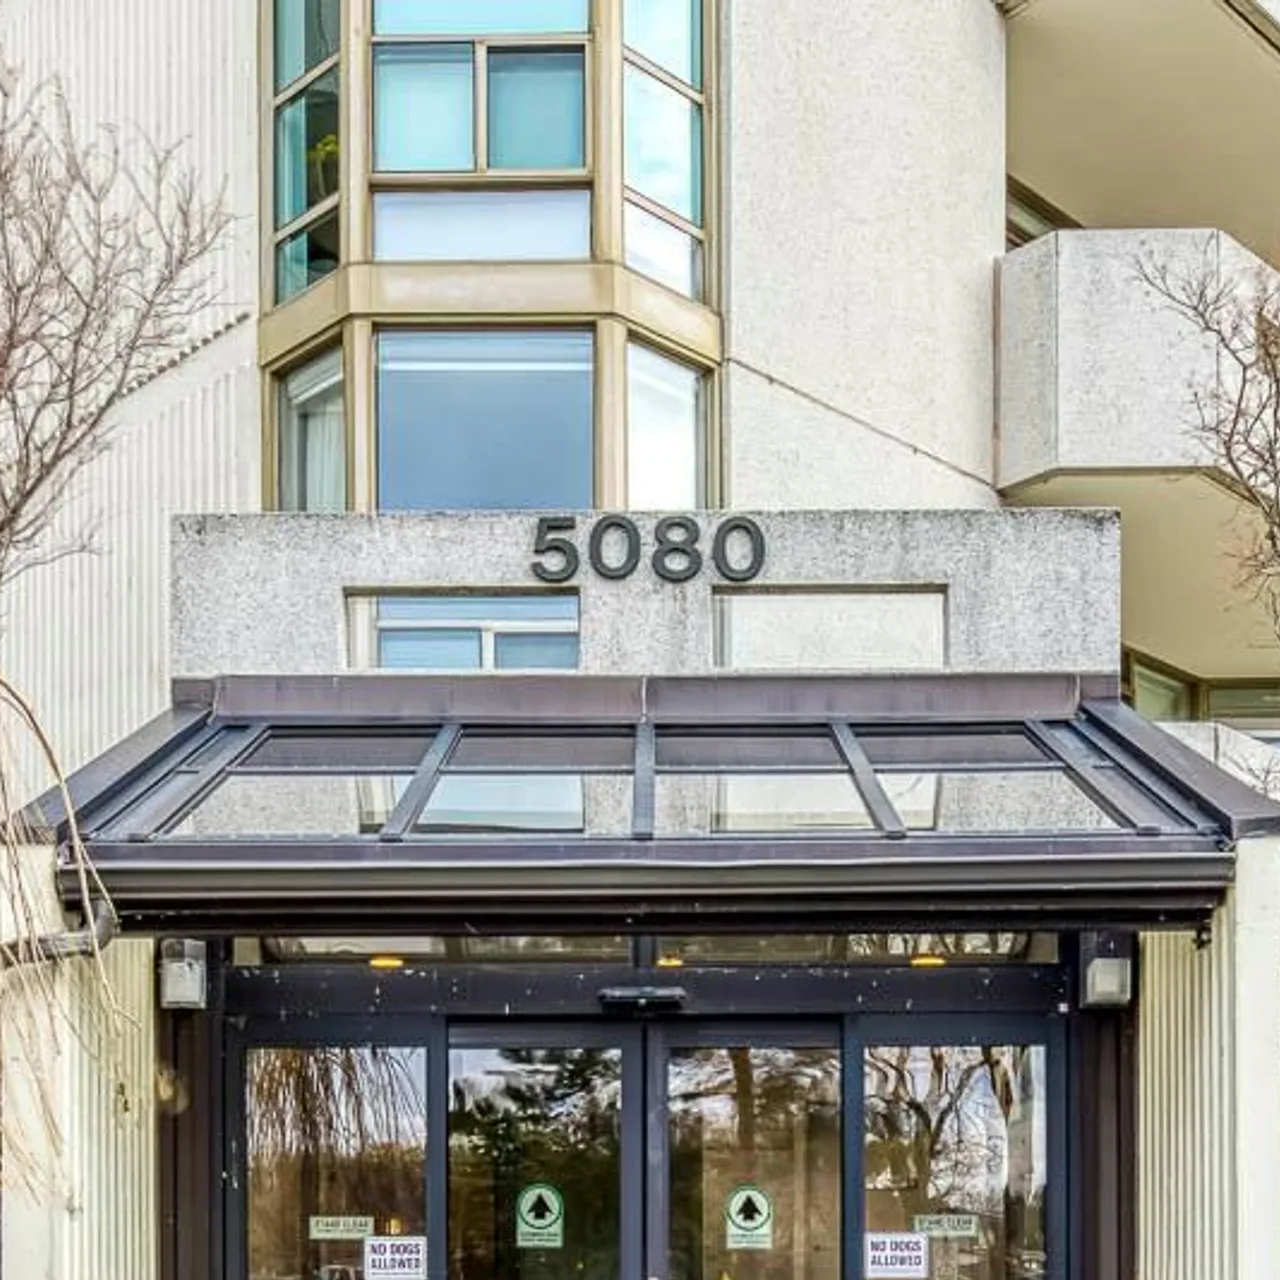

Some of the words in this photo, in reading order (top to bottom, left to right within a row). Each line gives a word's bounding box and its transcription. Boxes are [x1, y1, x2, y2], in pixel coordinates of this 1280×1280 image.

[531, 514, 765, 583] 5080
[370, 1243, 387, 1256] NO
[390, 1243, 421, 1256] DOGS
[870, 1241, 886, 1252] NO
[890, 1241, 922, 1252] DOGS
[371, 1257, 421, 1269] ALLOWED
[870, 1255, 922, 1267] ALLOWED
